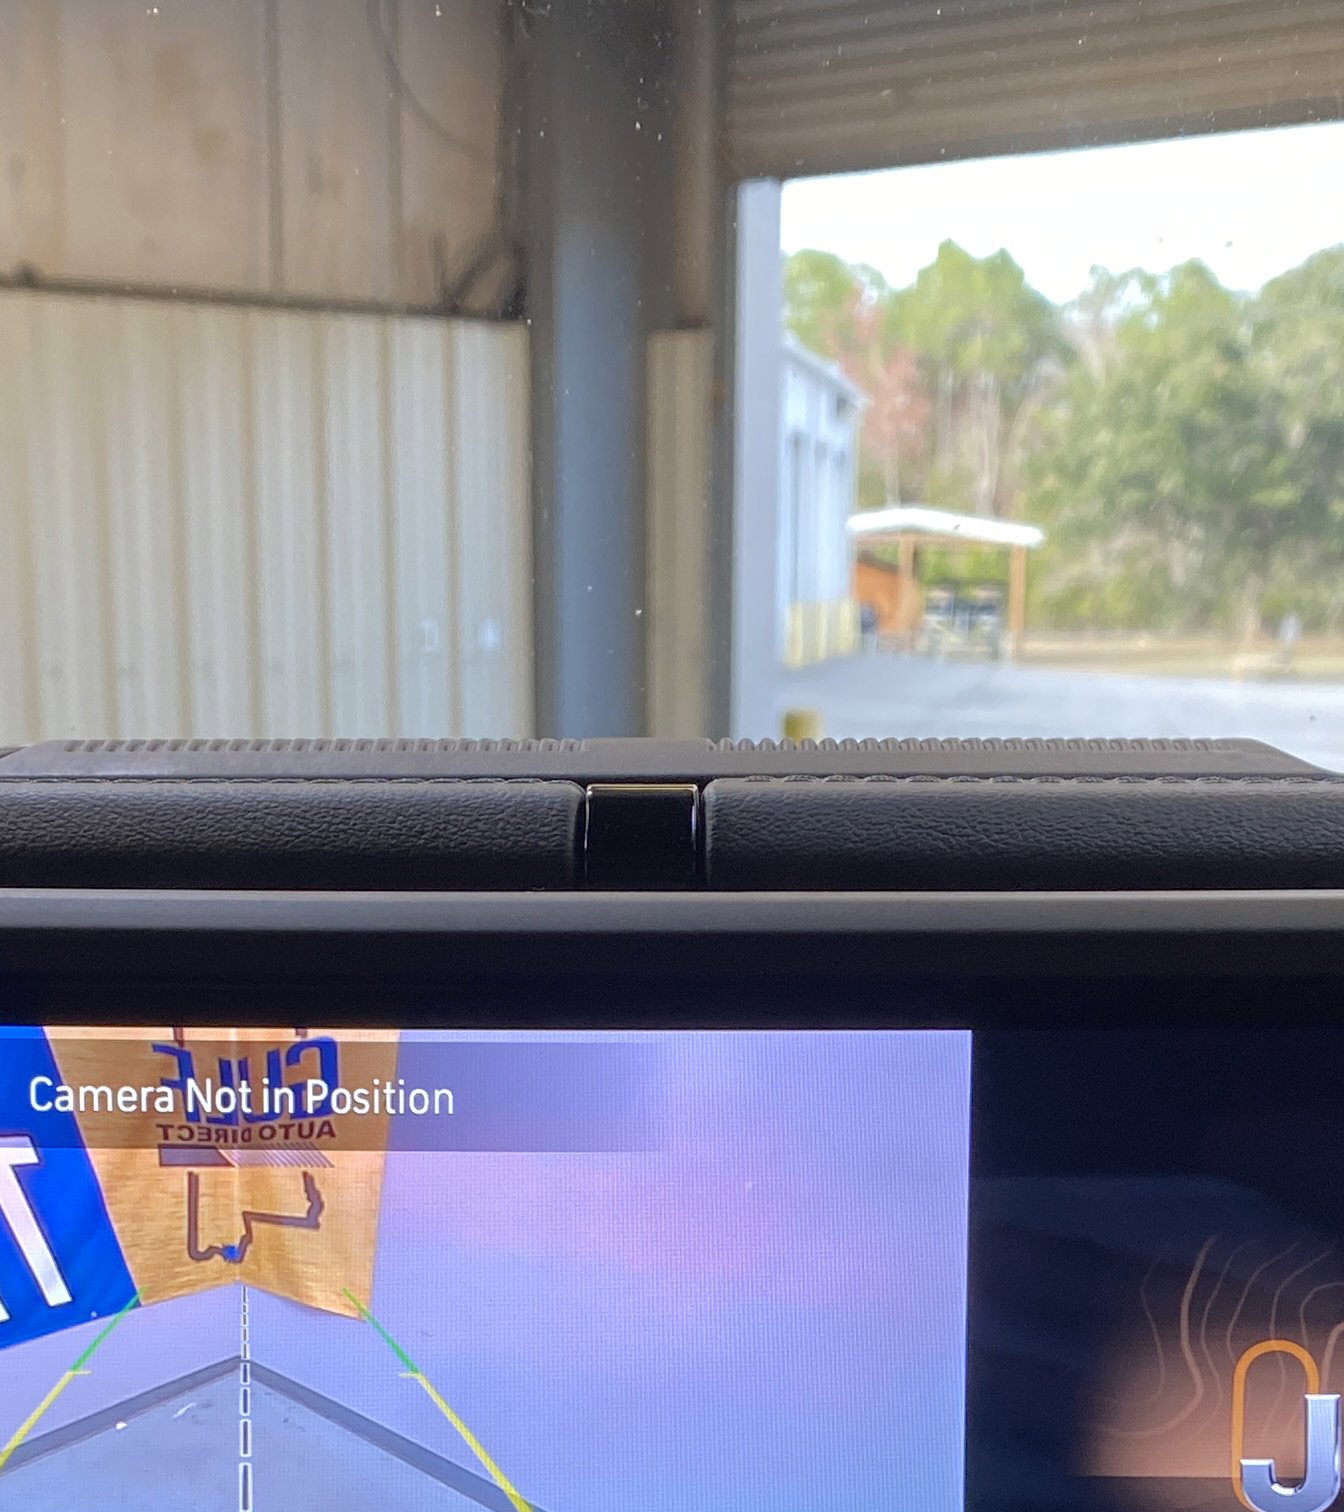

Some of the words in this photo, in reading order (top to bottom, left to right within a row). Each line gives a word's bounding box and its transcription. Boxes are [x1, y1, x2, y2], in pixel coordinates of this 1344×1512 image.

[29, 1076, 175, 1114] Camera
[187, 1078, 252, 1114] Not
[262, 1078, 296, 1114] in
[306, 1079, 455, 1116] Position
